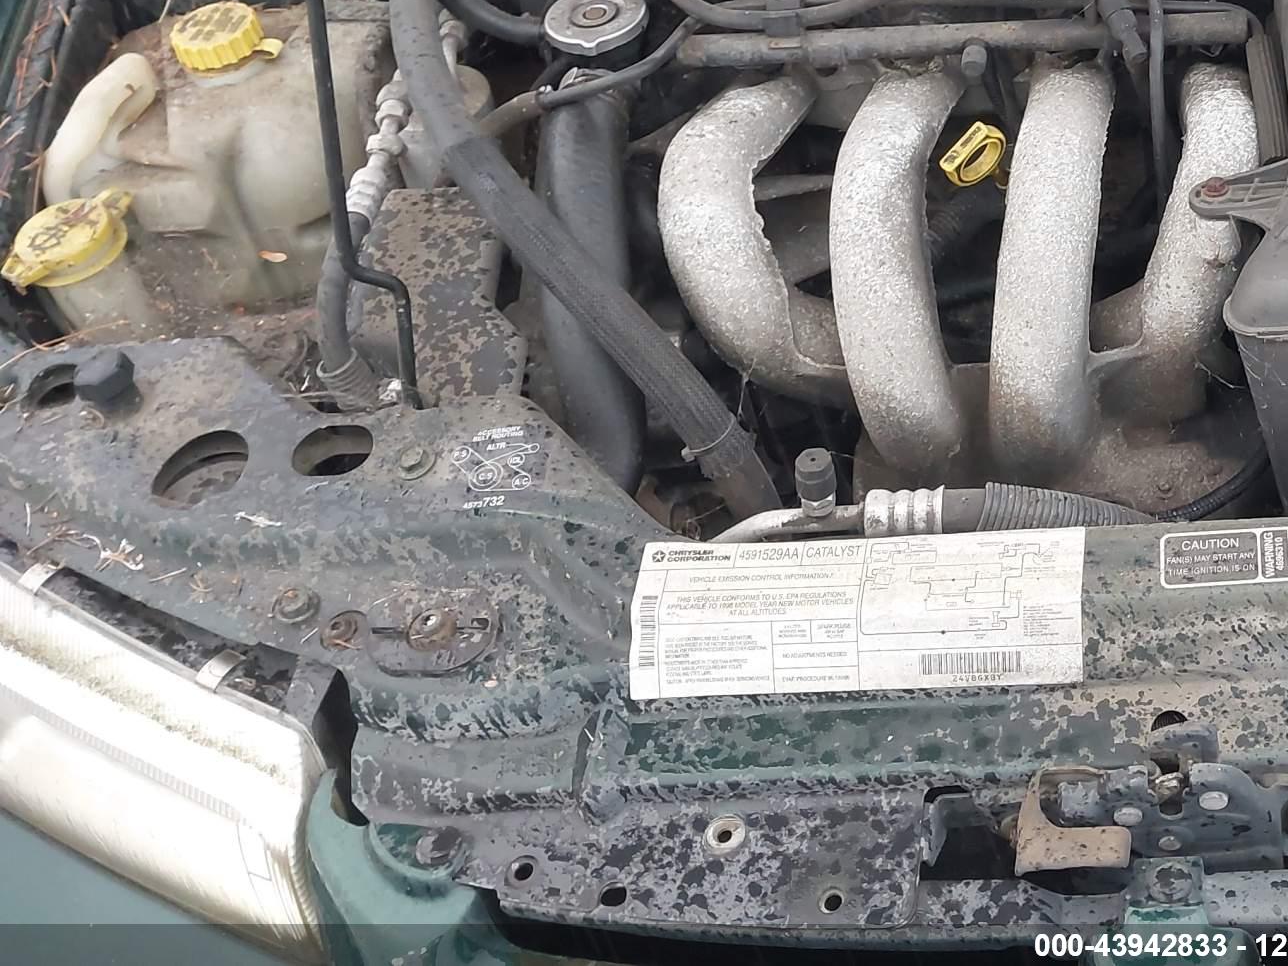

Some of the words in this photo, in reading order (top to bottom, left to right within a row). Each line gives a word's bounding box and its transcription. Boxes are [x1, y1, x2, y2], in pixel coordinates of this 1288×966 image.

[1181, 537, 1240, 551] CAUTION
[739, 547, 799, 561] 4591529AA
[806, 545, 862, 558] CATALYST
[1166, 555, 1193, 565] FAN(S)
[1194, 554, 1211, 562] MAY
[1212, 553, 1237, 561] START
[1239, 552, 1255, 560] ANY
[1263, 532, 1275, 578] WARNING
[1169, 567, 1189, 576] TIME
[1192, 566, 1229, 575] IGNITION
[1232, 564, 1240, 572] IS
[722, 594, 760, 602] CONFORMS
[800, 591, 847, 599] REGULATIONS
[666, 602, 706, 610] APPLICABLE
[759, 600, 778, 608] YEAR
[795, 599, 820, 607] MOTOR
